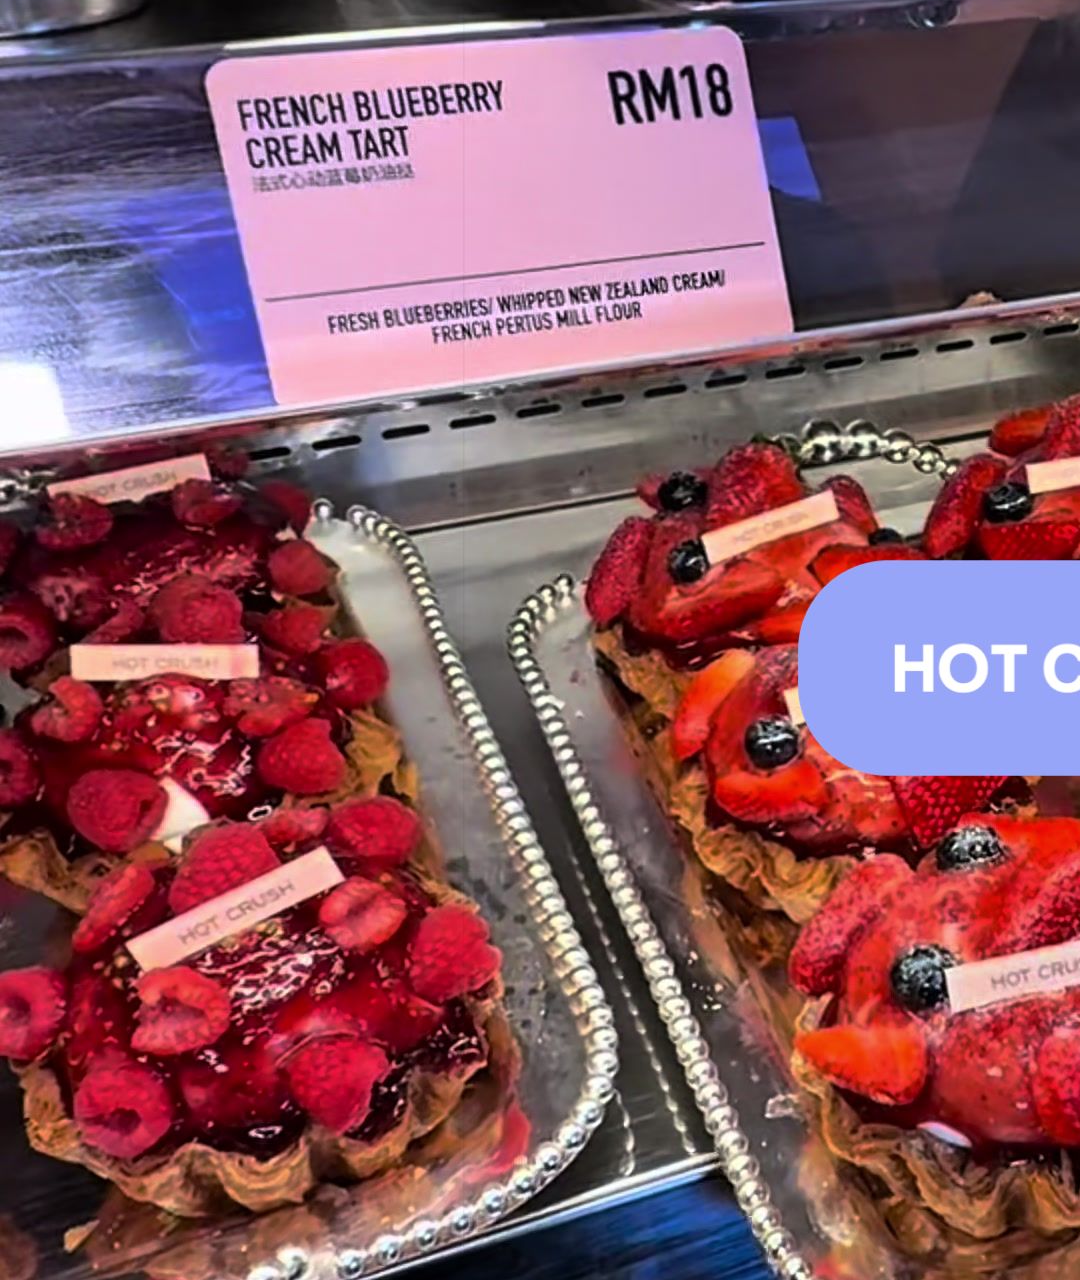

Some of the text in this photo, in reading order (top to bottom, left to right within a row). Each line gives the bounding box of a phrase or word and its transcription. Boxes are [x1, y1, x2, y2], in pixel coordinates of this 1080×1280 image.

[238, 63, 733, 131] FRENCH BLUEBERRY RM18
[246, 126, 411, 169] CREAM TART
[328, 312, 380, 334] FRESH
[384, 297, 493, 327] BLUEBERRIES/
[497, 287, 566, 314] WHIPPED
[569, 283, 602, 304] NEW
[606, 274, 669, 301] ZEALAND
[432, 301, 642, 344] FRENCH PERTUS MILL FLOUR
[112, 656, 219, 671] HOT CRUSH
[179, 879, 296, 945] HOT CRUSH
[991, 967, 1031, 990] HOT
